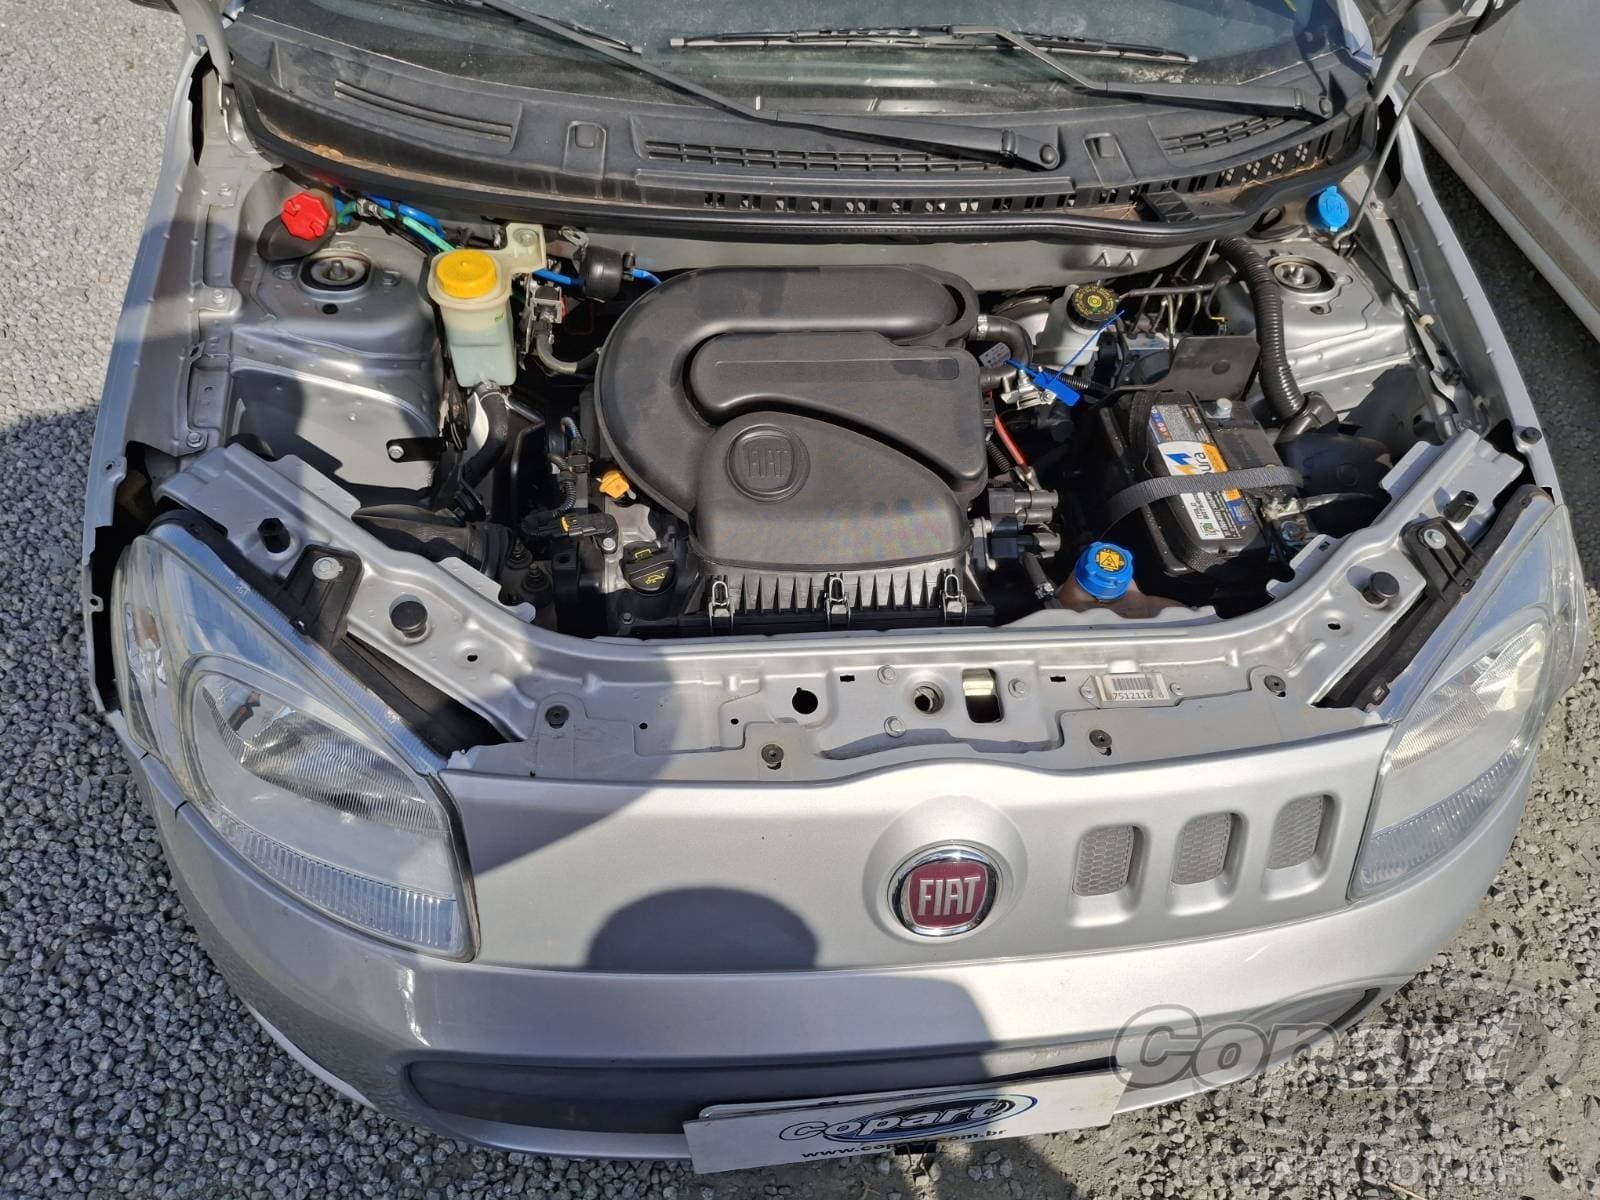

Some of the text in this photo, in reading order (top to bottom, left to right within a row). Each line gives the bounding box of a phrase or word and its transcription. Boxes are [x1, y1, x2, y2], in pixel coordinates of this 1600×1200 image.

[743, 450, 789, 478] FIAT
[917, 876, 981, 916] FIAT
[779, 1098, 1005, 1141] Copart
